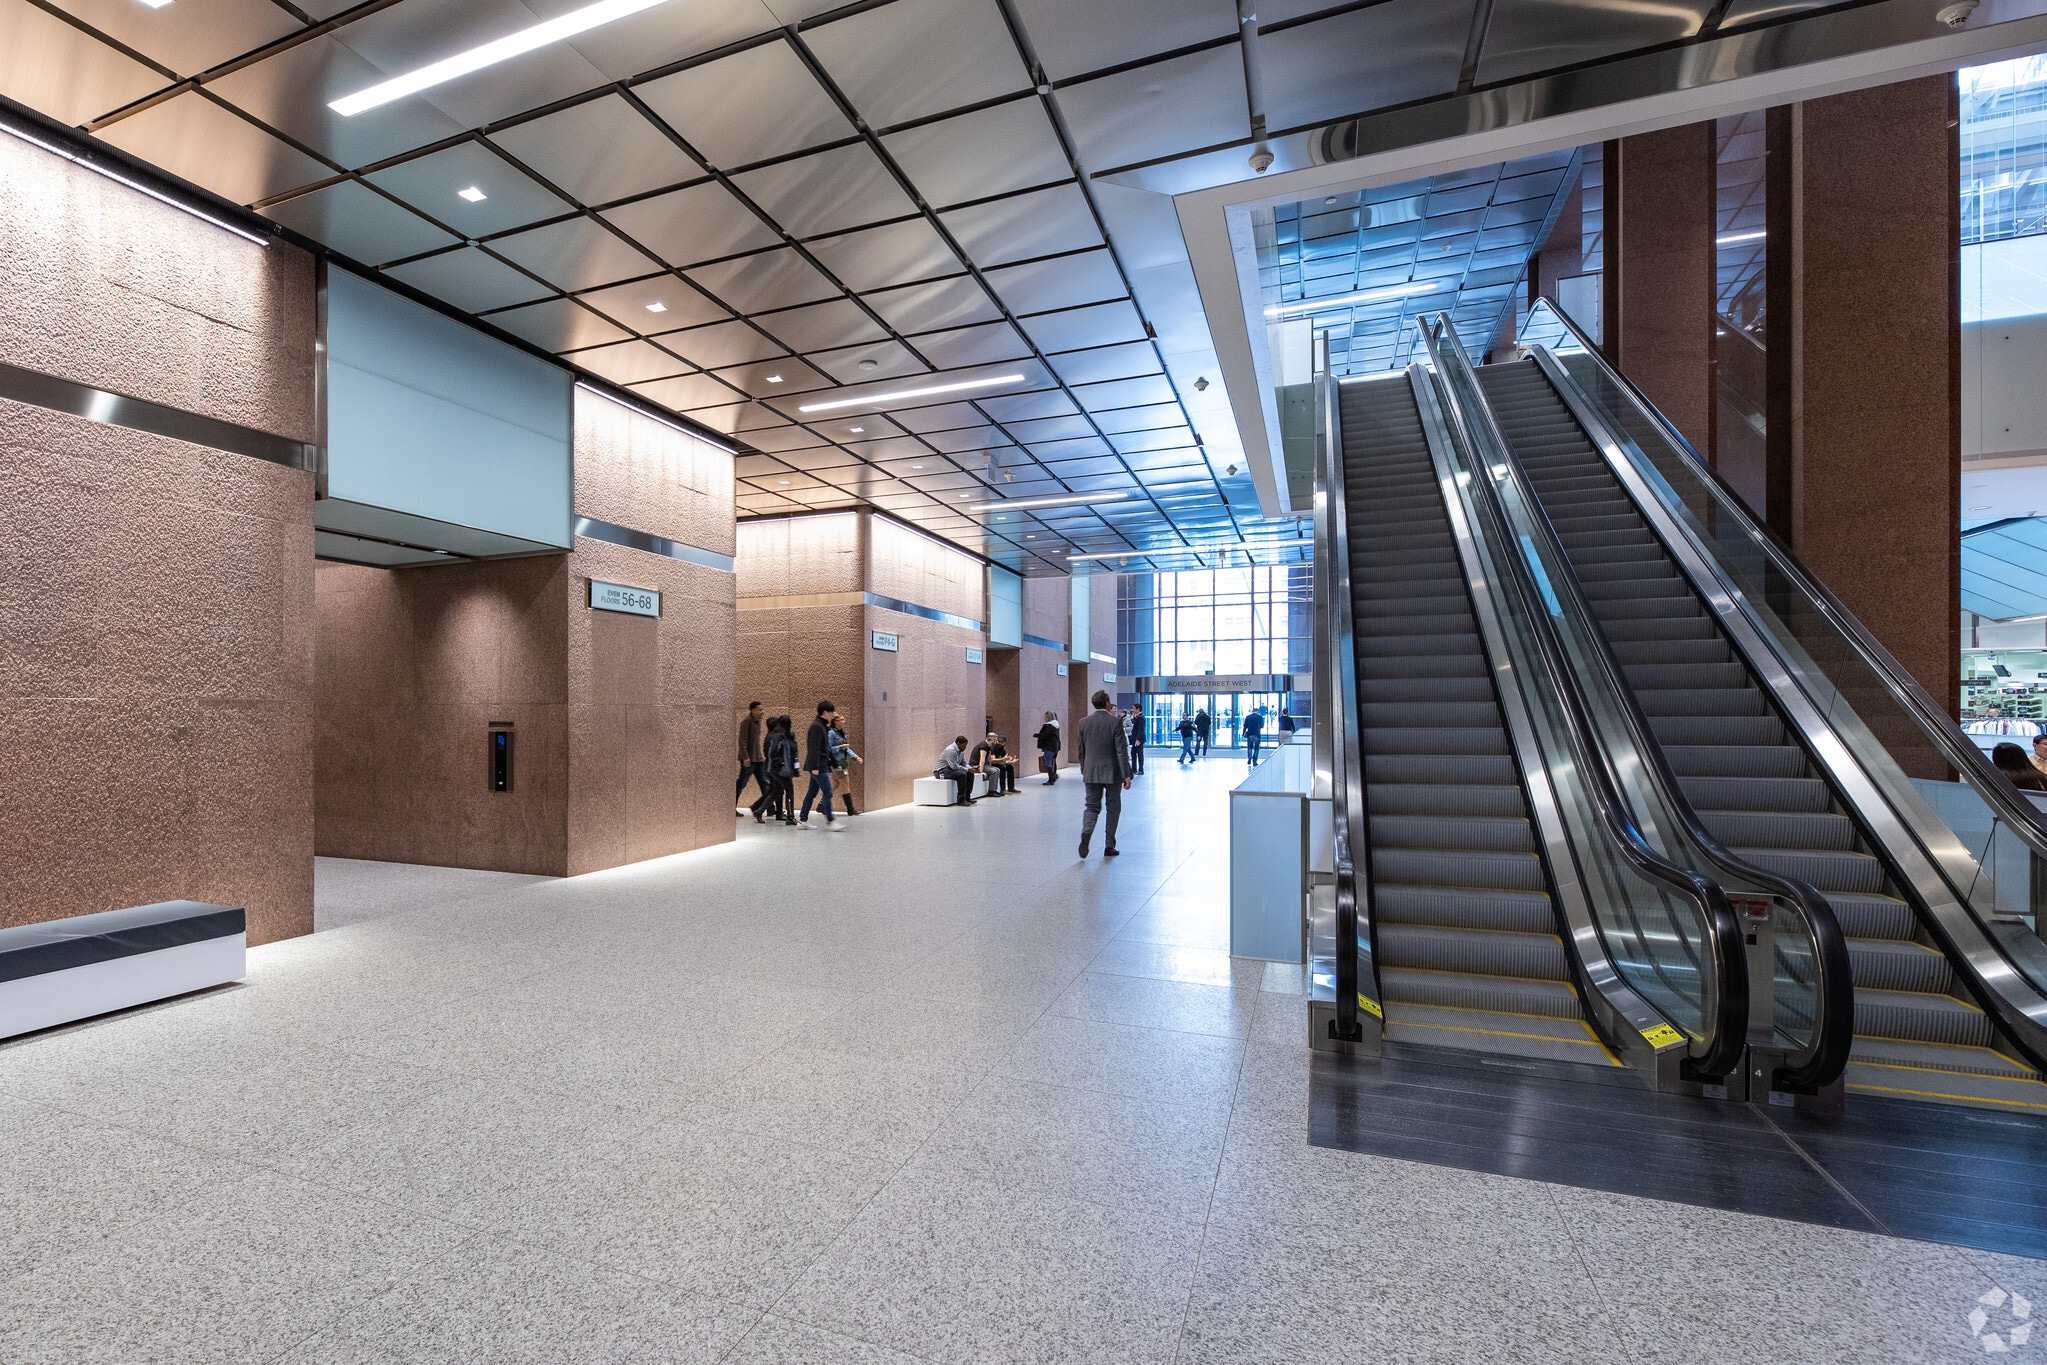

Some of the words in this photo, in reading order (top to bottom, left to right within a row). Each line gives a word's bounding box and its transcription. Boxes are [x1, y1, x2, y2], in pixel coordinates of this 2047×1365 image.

[607, 589, 620, 597] EVEN
[601, 595, 620, 605] FLOORS
[622, 592, 652, 609] 56-68
[1754, 1069, 1762, 1077] 4
